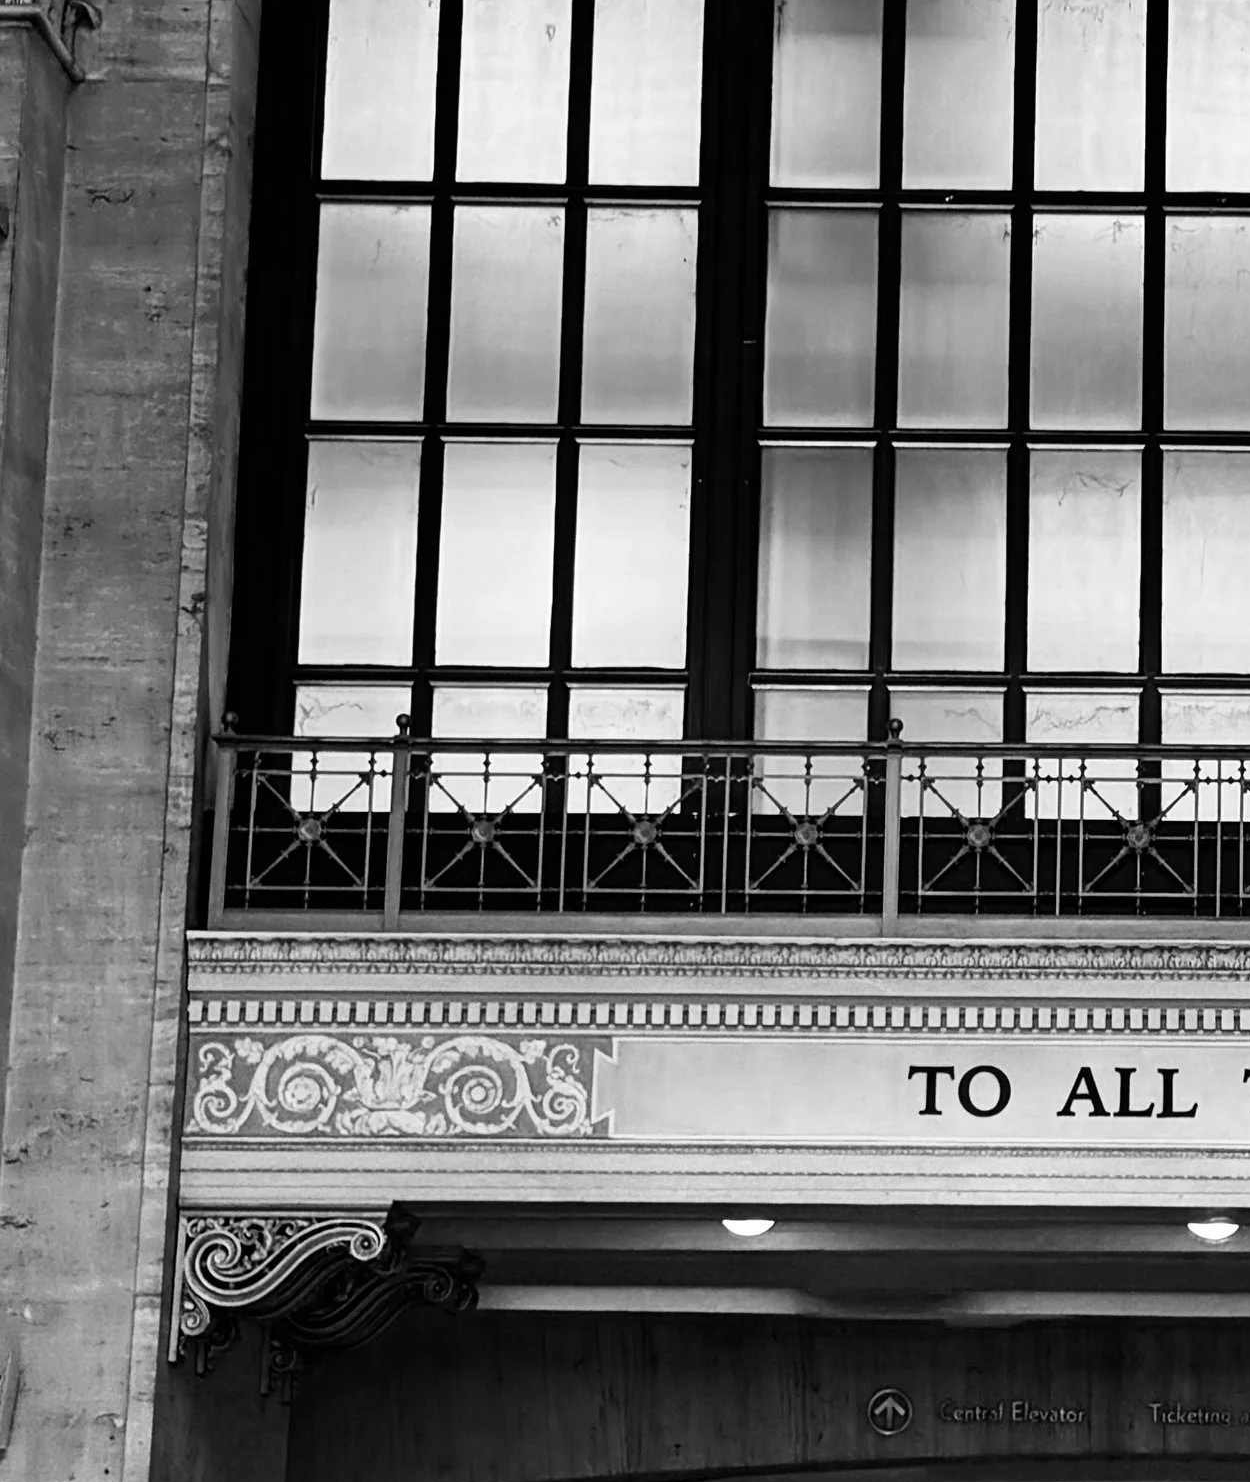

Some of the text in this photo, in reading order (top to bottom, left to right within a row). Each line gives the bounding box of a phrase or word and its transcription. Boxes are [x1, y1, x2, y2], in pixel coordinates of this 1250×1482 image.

[907, 1065, 1012, 1118] TO
[1056, 1066, 1199, 1119] ALL
[940, 1399, 1086, 1423] Central Elevator
[1149, 1403, 1231, 1427] Ticketing
